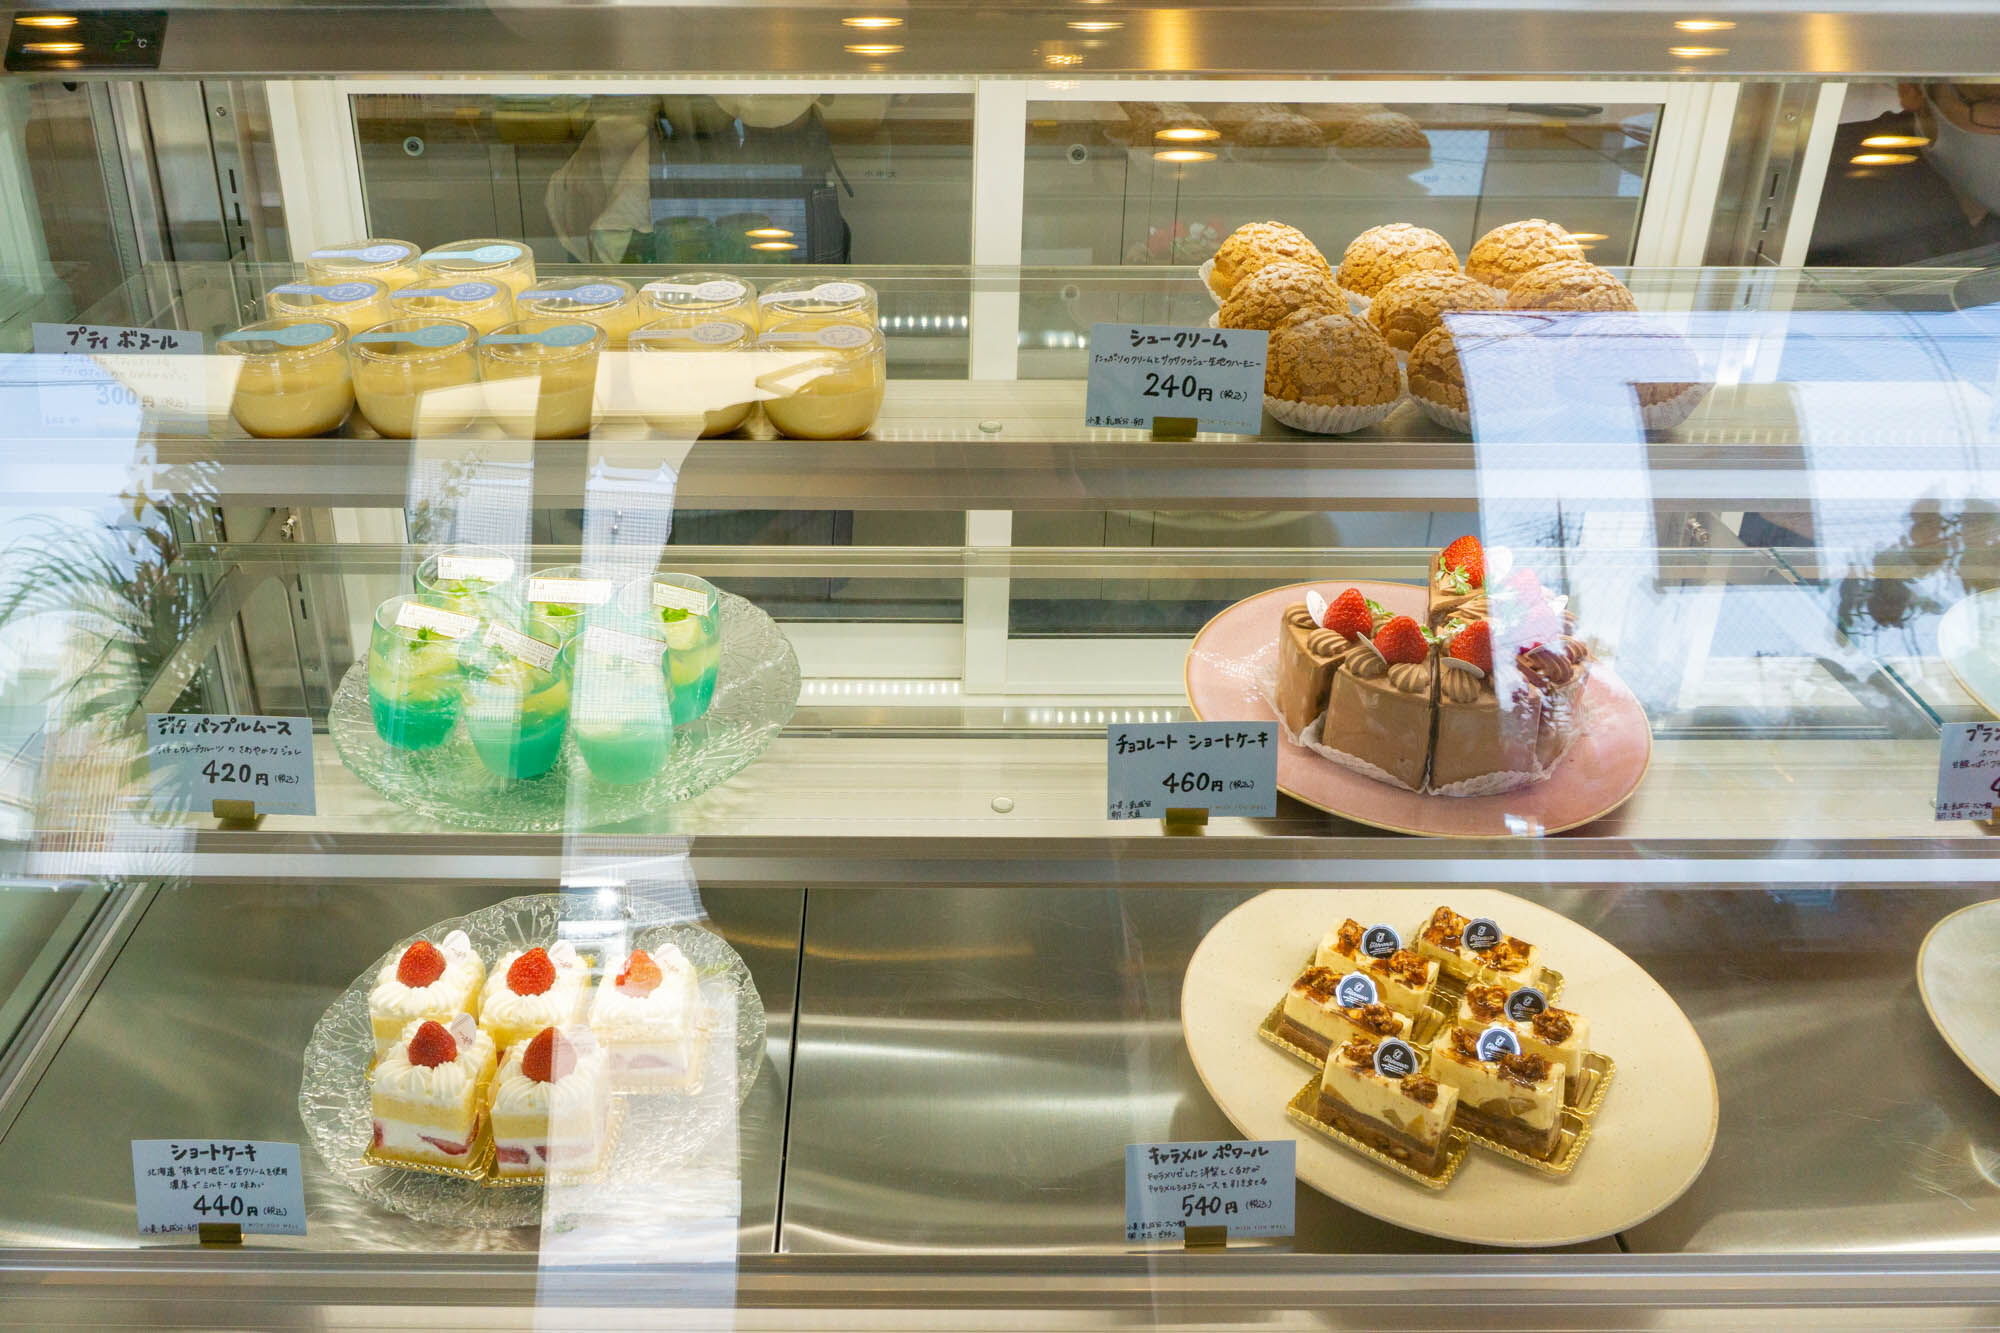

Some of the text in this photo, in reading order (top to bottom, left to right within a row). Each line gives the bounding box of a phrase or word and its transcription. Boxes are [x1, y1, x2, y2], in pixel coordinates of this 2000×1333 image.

[66, 326, 108, 349] プティ
[1130, 329, 1229, 349] シュークリーム
[1143, 372, 1214, 402] 240円
[194, 716, 293, 736] パンプルムース
[1115, 730, 1270, 755] チョコレート ショートケーキ
[202, 759, 270, 787] 420円
[1161, 771, 1224, 795] 460円
[170, 1143, 258, 1163] ショートケーキ
[1148, 1143, 1270, 1166] キャラメル ポワール
[192, 1194, 259, 1217] 440円
[1181, 1194, 1239, 1218] 540円
